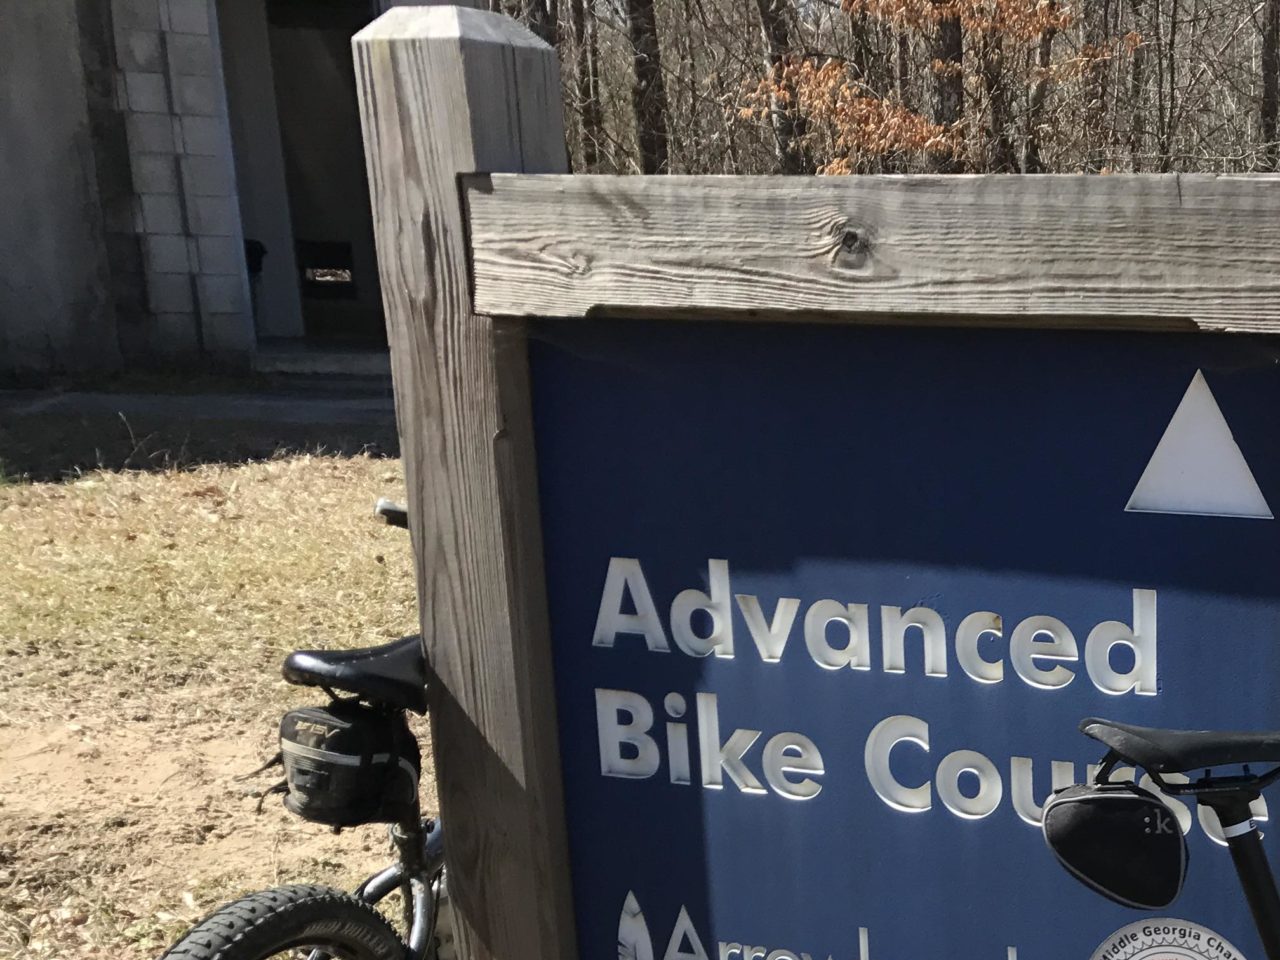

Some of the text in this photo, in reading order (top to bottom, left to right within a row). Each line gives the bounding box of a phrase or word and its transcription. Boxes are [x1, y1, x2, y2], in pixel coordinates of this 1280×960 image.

[592, 557, 1158, 696] Advanced
[595, 688, 825, 800] Bike
[1142, 925, 1201, 942] Georgia
